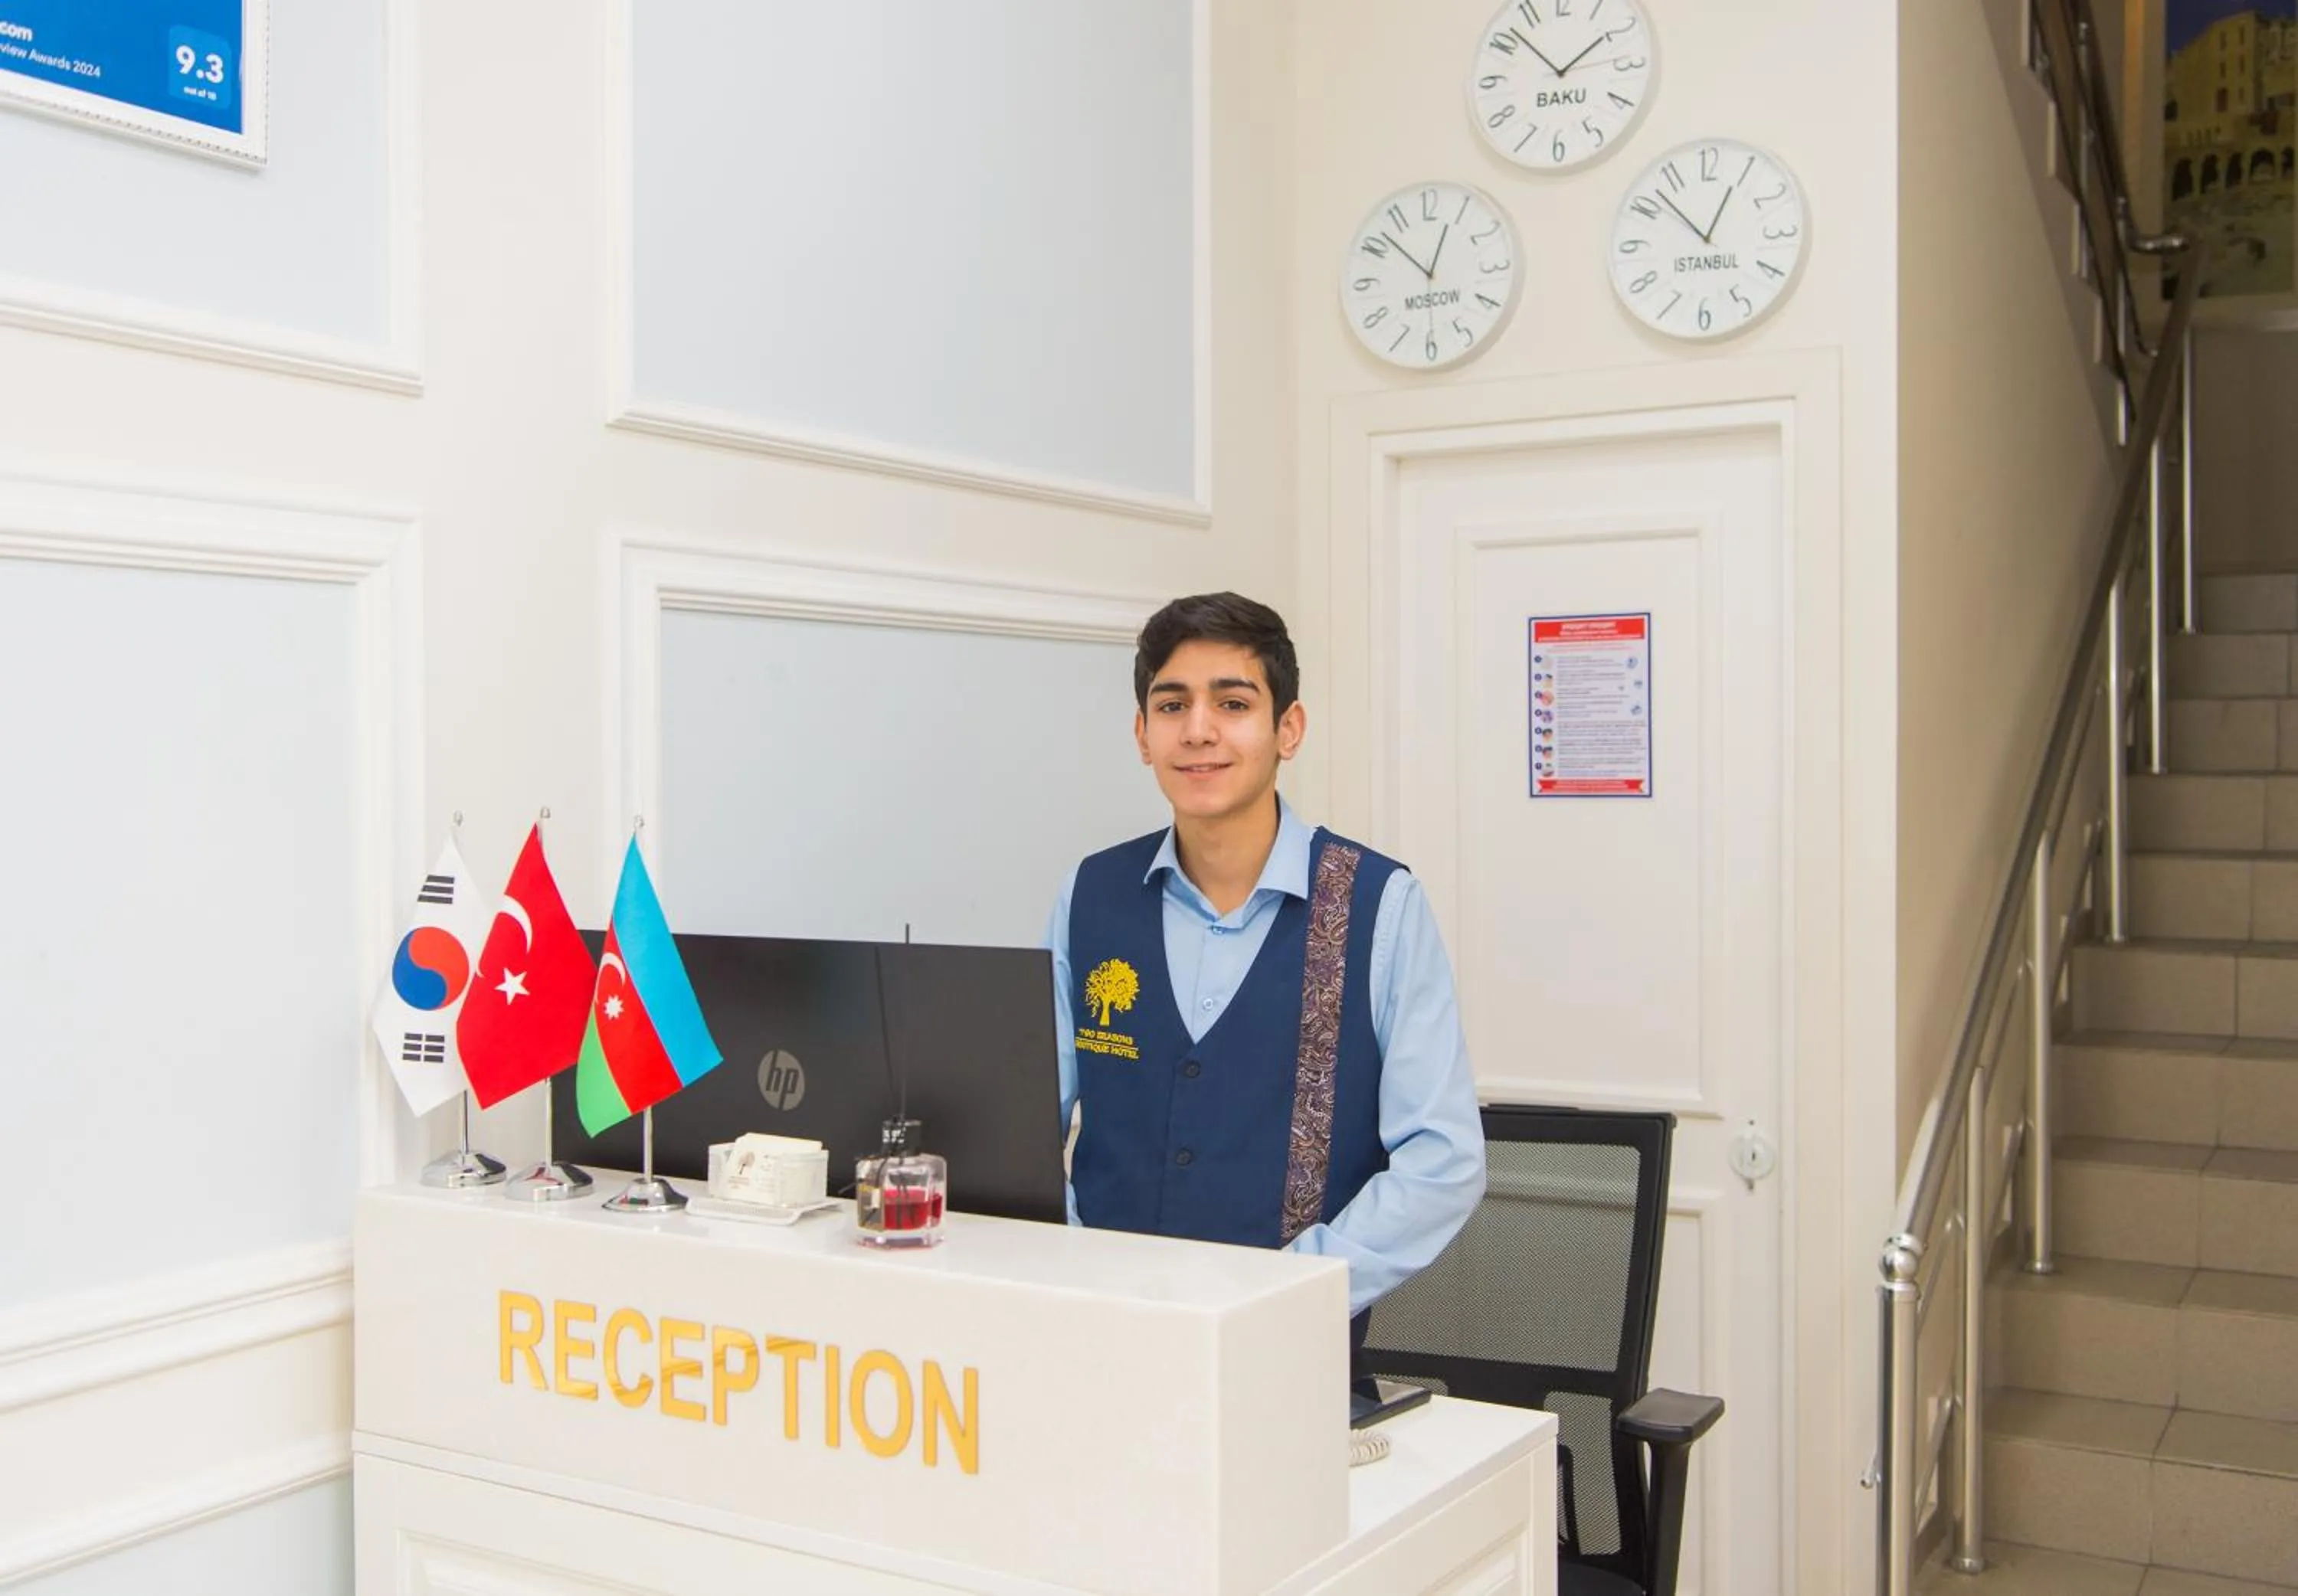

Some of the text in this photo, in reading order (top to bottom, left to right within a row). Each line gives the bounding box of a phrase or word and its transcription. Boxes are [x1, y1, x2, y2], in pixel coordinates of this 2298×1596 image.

[1606, 16, 1636, 42] 2
[1489, 32, 1518, 55] 10
[28, 48, 70, 70] Awards
[73, 60, 100, 77] 2024
[176, 45, 224, 83] 9.3
[1613, 57, 1646, 71] 3
[1478, 75, 1507, 90] 9
[1537, 88, 1586, 107] BAKU
[1488, 104, 1516, 129] 8
[1514, 123, 1537, 152] 7
[1553, 128, 1566, 162] 6
[1582, 116, 1604, 148] 5
[1661, 161, 1685, 193] 11
[1699, 147, 1719, 182] 12
[1737, 155, 1755, 187] 1
[1421, 189, 1439, 221] 12
[1455, 195, 1470, 224] 1
[1629, 195, 1661, 220] 10
[1753, 182, 1786, 209] 2
[1387, 203, 1409, 233] 11
[1470, 219, 1501, 245] 2
[1763, 224, 1798, 240] 3
[1361, 235, 1389, 259] 10
[1619, 239, 1651, 254] 9
[1479, 260, 1511, 274] 3
[1674, 253, 1740, 273] ISTANBUL
[1353, 277, 1381, 291] 9
[1629, 270, 1658, 294] 8
[1405, 289, 1461, 310] MOSCOW
[1656, 289, 1683, 319] 7
[1698, 296, 1711, 331] 6
[1729, 283, 1753, 318] 5
[1363, 306, 1389, 329] 8
[1389, 322, 1410, 352] 7
[1452, 316, 1473, 348] 5
[1425, 332, 1438, 361] 6
[1111, 1045, 1139, 1059] HOTEL
[766, 1049, 799, 1110] hp
[499, 1290, 980, 1475] RECEPTION
